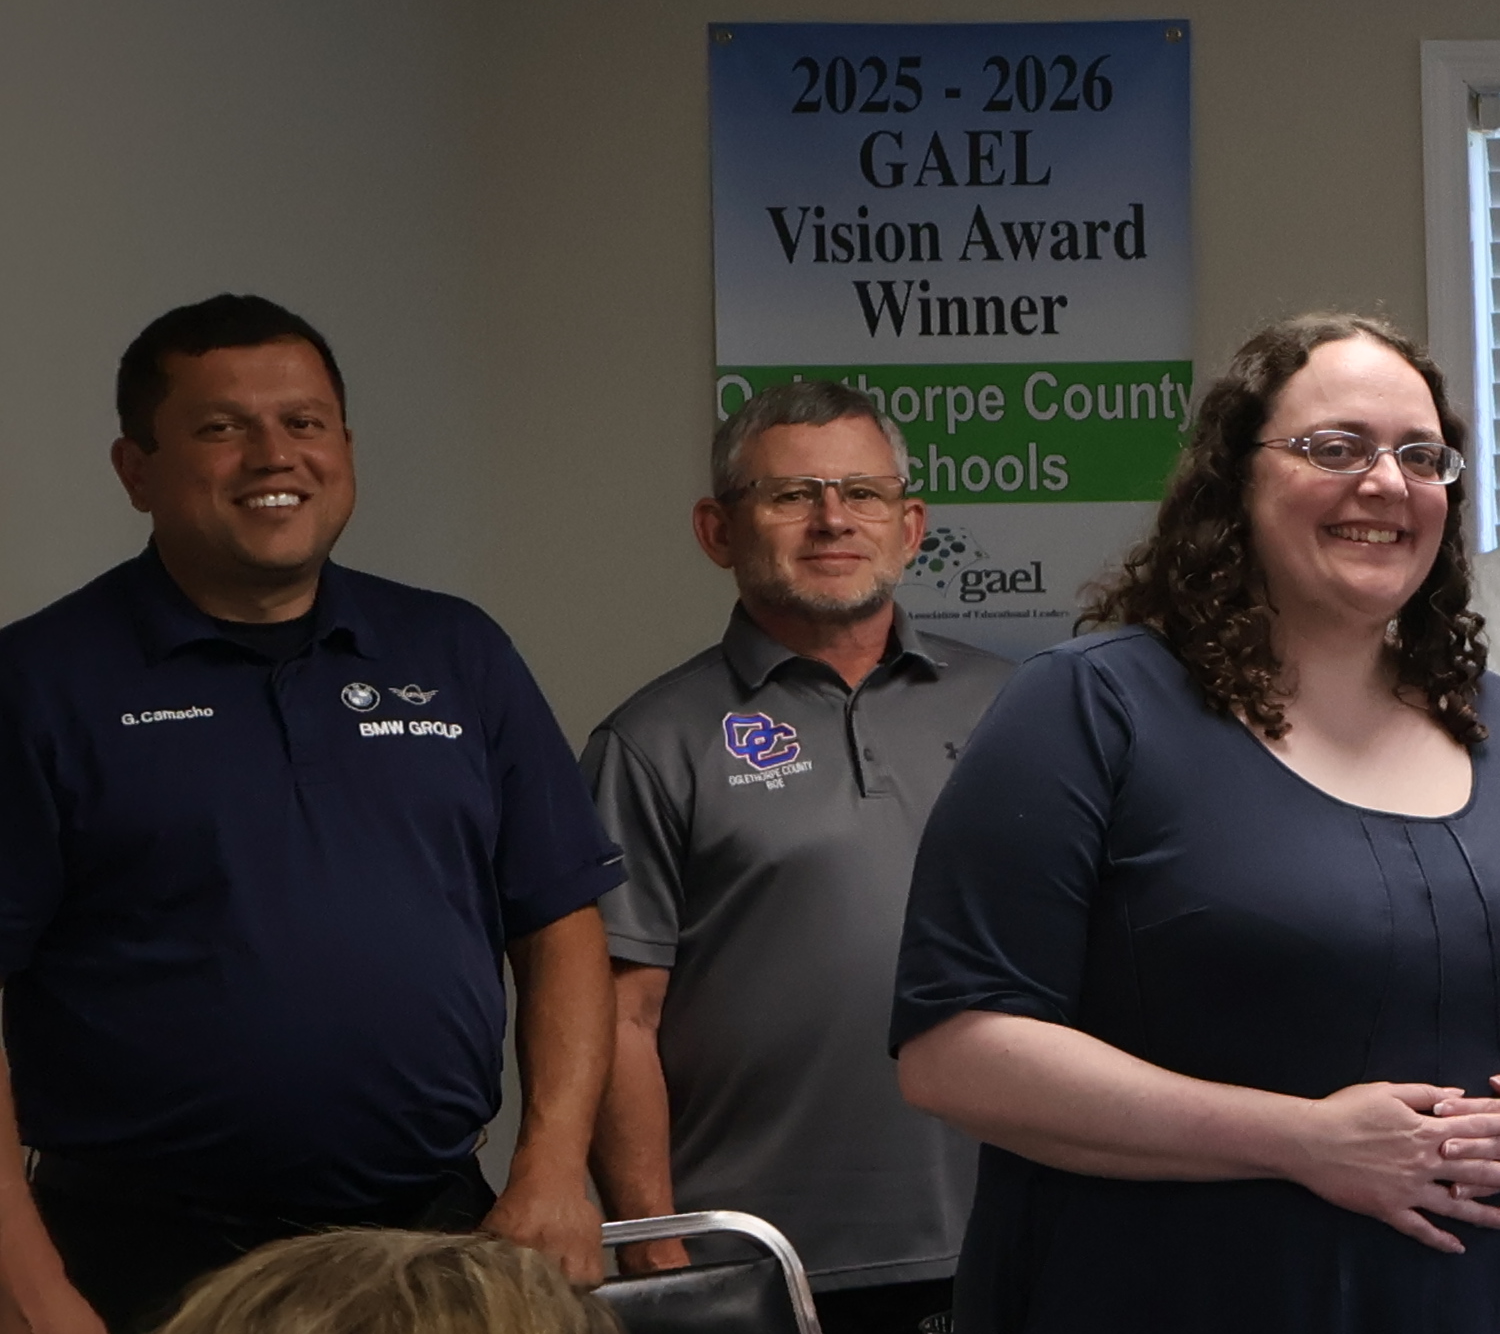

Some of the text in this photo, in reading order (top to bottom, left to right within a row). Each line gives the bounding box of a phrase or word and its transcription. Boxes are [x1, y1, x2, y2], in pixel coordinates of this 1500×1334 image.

[792, 54, 923, 114] 2025
[983, 53, 1113, 112] 2026
[859, 128, 1051, 189] GAEL
[766, 203, 1148, 264] Vision Award
[853, 278, 1068, 338] Winner
[908, 442, 1069, 492] chools
[959, 561, 1047, 604] gael
[359, 720, 463, 739] BMW GROUP
